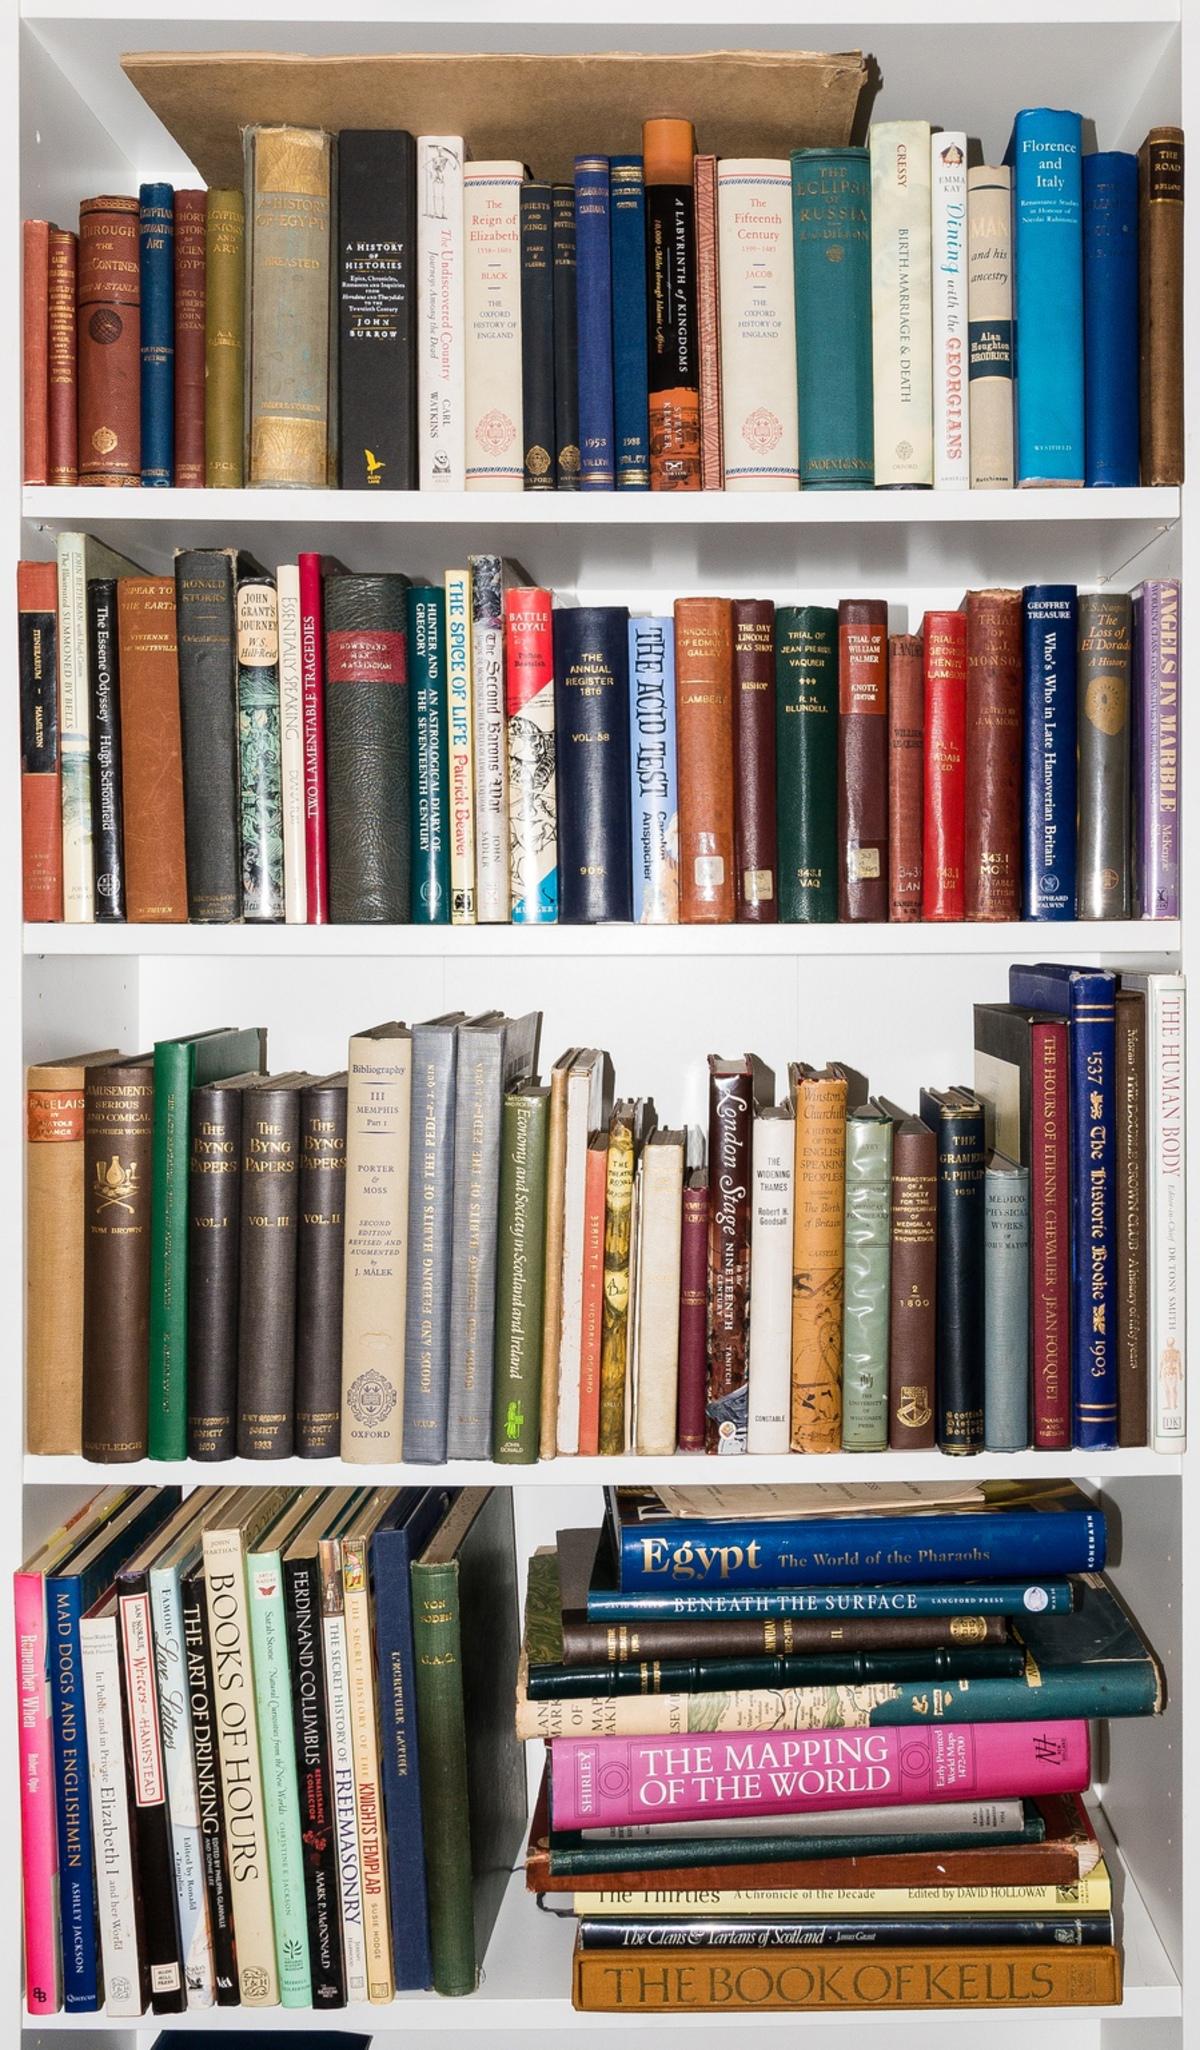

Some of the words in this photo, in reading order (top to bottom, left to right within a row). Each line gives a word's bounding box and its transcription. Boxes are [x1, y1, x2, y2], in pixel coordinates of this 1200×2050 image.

[897, 144, 907, 188] CRESSY
[1022, 140, 1077, 153] Florence
[1039, 158, 1062, 171] and
[1036, 176, 1065, 191] Italy
[470, 231, 519, 241] Elizabeth
[472, 215, 502, 227] Reign
[735, 213, 782, 224] Fifteenth
[737, 230, 779, 241] Century
[941, 202, 965, 274] Dining
[675, 211, 686, 285] LABYRINTH
[971, 250, 990, 261] and
[441, 250, 453, 329] Undiscovered
[970, 271, 1009, 284] ancestry
[898, 274, 912, 342] MARRIAGE
[441, 332, 453, 382] Country
[677, 303, 689, 373] KINGDOMS
[901, 360, 911, 403] DEATH
[945, 337, 962, 460] GEORGIANS
[663, 402, 672, 449] KEMPER
[97, 606, 109, 624] The
[244, 593, 268, 605] JOHN
[450, 581, 463, 616] THE
[509, 613, 549, 622] BATTLE
[1028, 611, 1071, 619] TREASURE
[416, 603, 426, 657] GREGORY
[427, 603, 437, 651] HUNTER
[511, 623, 546, 631] ROYAL
[1098, 614, 1118, 625] The
[1160, 585, 1177, 674] ANGELS
[62, 614, 72, 678] SUMMONED
[97, 634, 109, 668] Essene
[304, 615, 315, 681] TRAGEDIES
[428, 654, 438, 679] AND
[450, 622, 466, 672] SPICE
[581, 653, 603, 662] THE
[635, 628, 664, 673] THE
[1044, 632, 1056, 671] Who's
[451, 675, 467, 702] OF
[565, 677, 614, 686] REGISTER
[570, 665, 611, 674] ANNUAL
[1045, 675, 1056, 703] Who
[96, 670, 111, 720] Odyssey
[417, 690, 427, 712] THE
[429, 688, 438, 706] AN
[636, 679, 667, 735] ACID
[1159, 682, 1177, 705] IN
[305, 690, 318, 787] LAMENTABLE
[451, 706, 468, 746] LIFE
[1045, 722, 1056, 748] Late
[98, 735, 112, 769] Hugh
[417, 717, 430, 795] SEVENTEENTH
[430, 709, 441, 793] ASTROLOGICAL
[636, 742, 669, 798] TEST
[1160, 715, 1177, 812] MARBLE
[453, 754, 469, 806] Patrick
[1044, 753, 1057, 822] Hanoverian
[307, 788, 319, 819] TWO
[431, 798, 441, 835] DIARY
[419, 800, 429, 851] CENTURY
[456, 809, 470, 857] Beaver
[1044, 825, 1057, 866] Britain
[1162, 997, 1180, 1037] THE
[352, 1064, 405, 1075] Bibliography
[1044, 1037, 1056, 1065] THE
[1087, 1052, 1103, 1086] 1537
[1044, 1074, 1057, 1119] HOURS
[1162, 1045, 1181, 1120] HUMAN
[257, 1121, 283, 1135] THE
[356, 1106, 399, 1114] MEMPHIS
[717, 1089, 748, 1169] London
[251, 1138, 291, 1153] BYNG
[512, 1109, 531, 1163] Economy
[1044, 1124, 1056, 1141] OF
[1090, 1126, 1106, 1160] The
[1162, 1127, 1181, 1177] BODY
[245, 1158, 294, 1173] PAPERS
[358, 1165, 394, 1173] PORTER
[515, 1167, 527, 1195] and
[756, 1170, 791, 1179] WIDENING
[1044, 1145, 1056, 1203] ETIENNE
[363, 1186, 388, 1194] MOSS
[716, 1176, 746, 1235] Stage
[760, 1183, 789, 1191] THAMES
[1090, 1167, 1107, 1238] Historie
[509, 1195, 529, 1237] Society
[759, 1216, 787, 1226] Goodsall
[1043, 1209, 1057, 1286] CHEVALIER
[512, 1250, 527, 1304] Scotland
[724, 1243, 735, 1331] NINETEENTH
[1091, 1246, 1108, 1300] Booke
[511, 1305, 523, 1332] and
[1042, 1294, 1057, 1329] JEAN
[509, 1334, 525, 1380] Ireland
[1042, 1335, 1058, 1401] FOUQUET
[1089, 1341, 1106, 1377] 1903
[350, 1430, 391, 1439] OXFORD
[640, 1538, 762, 1581] Egypt
[778, 1554, 807, 1568] The
[814, 1552, 860, 1567] World
[866, 1552, 883, 1563] of
[887, 1551, 912, 1563] the
[918, 1548, 991, 1563] Pharaohs
[56, 1594, 72, 1635] MAD
[161, 1588, 175, 1636] FAMOUS
[294, 1571, 313, 1666] FERDINAND
[674, 1597, 769, 1613] BENEATH
[777, 1596, 817, 1610] THE
[825, 1594, 918, 1611] SURFACE
[184, 1604, 203, 1646] THE
[210, 1573, 244, 1690] BOOKS
[20, 1635, 38, 1691] Remember
[59, 1644, 74, 1693] DOGS
[187, 1651, 207, 1695] ART
[330, 1647, 342, 1684] SECRET
[23, 1695, 40, 1728] When
[60, 1701, 76, 1742] AND
[191, 1693, 210, 1721] OF
[221, 1702, 248, 1747] OF
[300, 1671, 320, 1765] COLUMBUS
[332, 1690, 347, 1745] HISTORY
[639, 1747, 713, 1777] THE
[724, 1735, 889, 1771] MAPPING
[194, 1726, 220, 1834] DRINKING
[580, 1752, 592, 1813] SHIRLEY
[639, 1779, 685, 1807] OF
[691, 1773, 762, 1803] THE
[767, 1766, 891, 1798] WORLD
[63, 1749, 82, 1867] ENGLISHMEN
[100, 1786, 120, 1866] Elizabeth
[225, 1758, 259, 1881] HOURS
[359, 1783, 379, 1837] KNIGHTS
[335, 1768, 361, 1926] FREEMASONRY
[362, 1838, 381, 1896] TEMPLAR
[71, 1882, 82, 1921] ASHLEY
[957, 1888, 988, 1899] DAVID
[990, 1887, 1047, 1899] HOLLOWAY
[72, 1925, 84, 1973] JACKSON
[621, 1930, 646, 1945] The
[648, 1930, 687, 1945] Clans
[707, 1930, 755, 1945] Tartans
[772, 1927, 825, 1944] Scotland
[604, 1967, 696, 2003] THE
[709, 1966, 848, 2002] BOOK
[854, 1965, 914, 2001] OF
[925, 1963, 1054, 2000] KELLS
